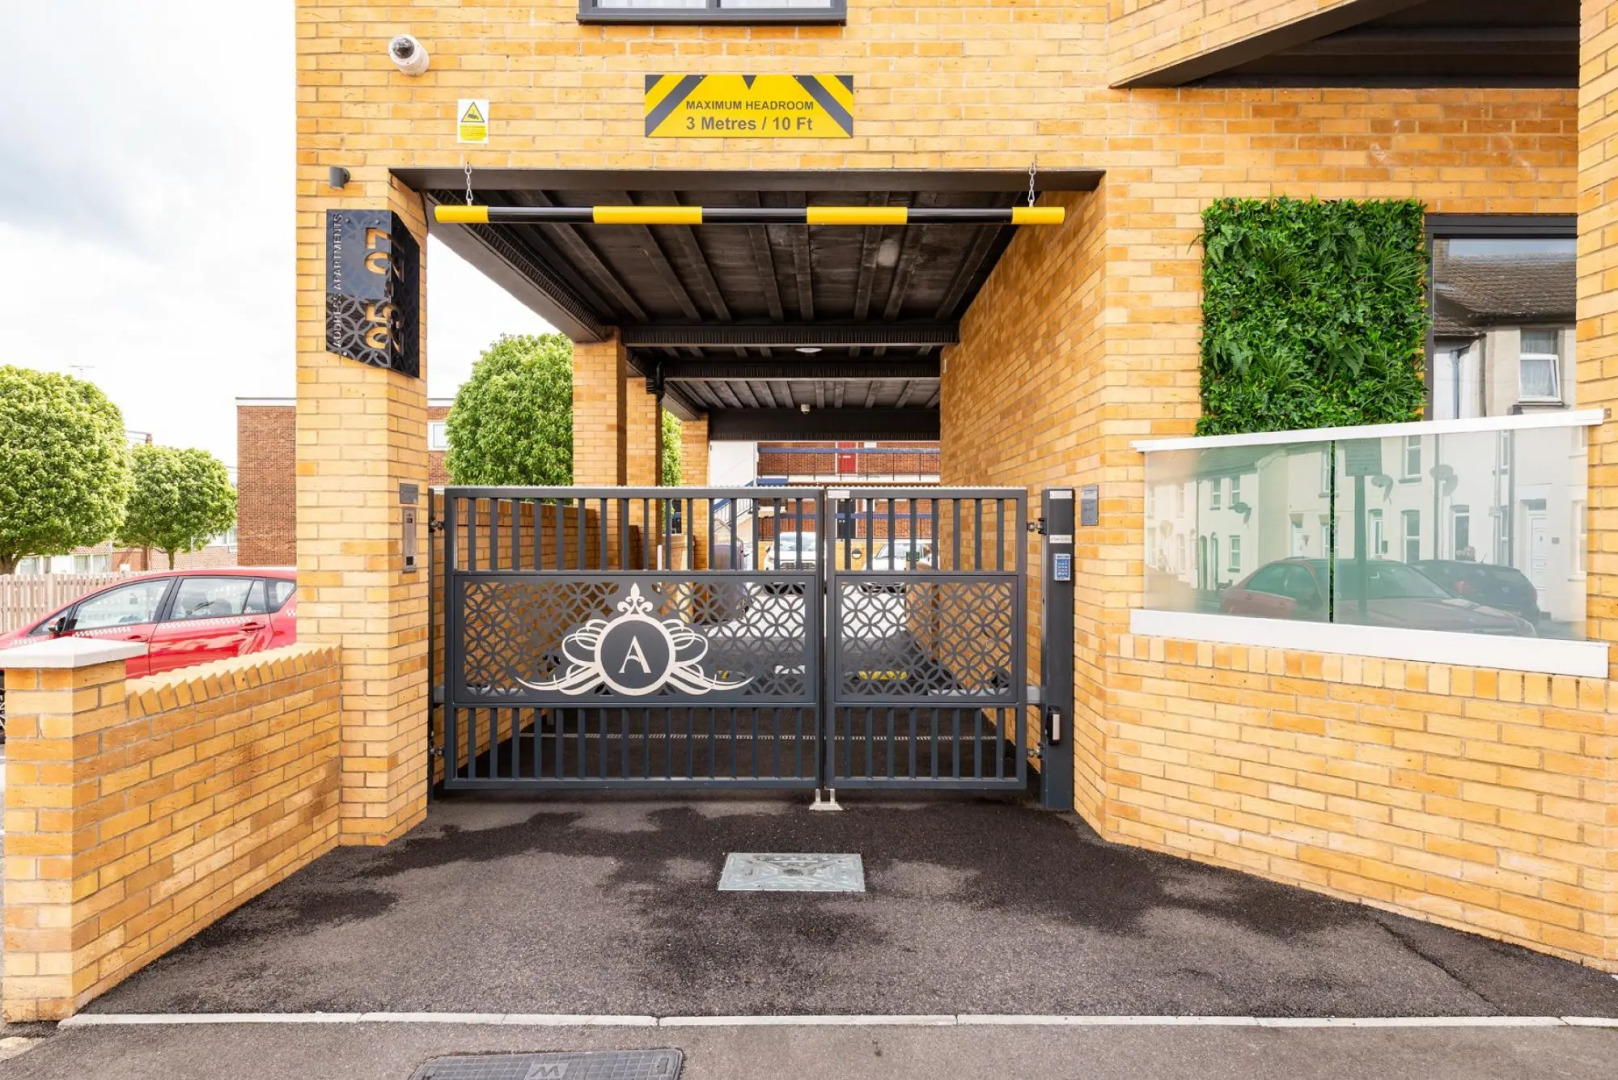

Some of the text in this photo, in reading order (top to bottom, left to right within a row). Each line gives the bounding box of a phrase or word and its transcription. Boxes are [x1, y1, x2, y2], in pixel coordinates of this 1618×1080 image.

[686, 100, 814, 110] MAXIMUM HEADROOM
[686, 116, 813, 131] 3 Metres / 10 Ft
[332, 214, 342, 348] ADDRESS APARTMENTS
[619, 635, 652, 674] A
